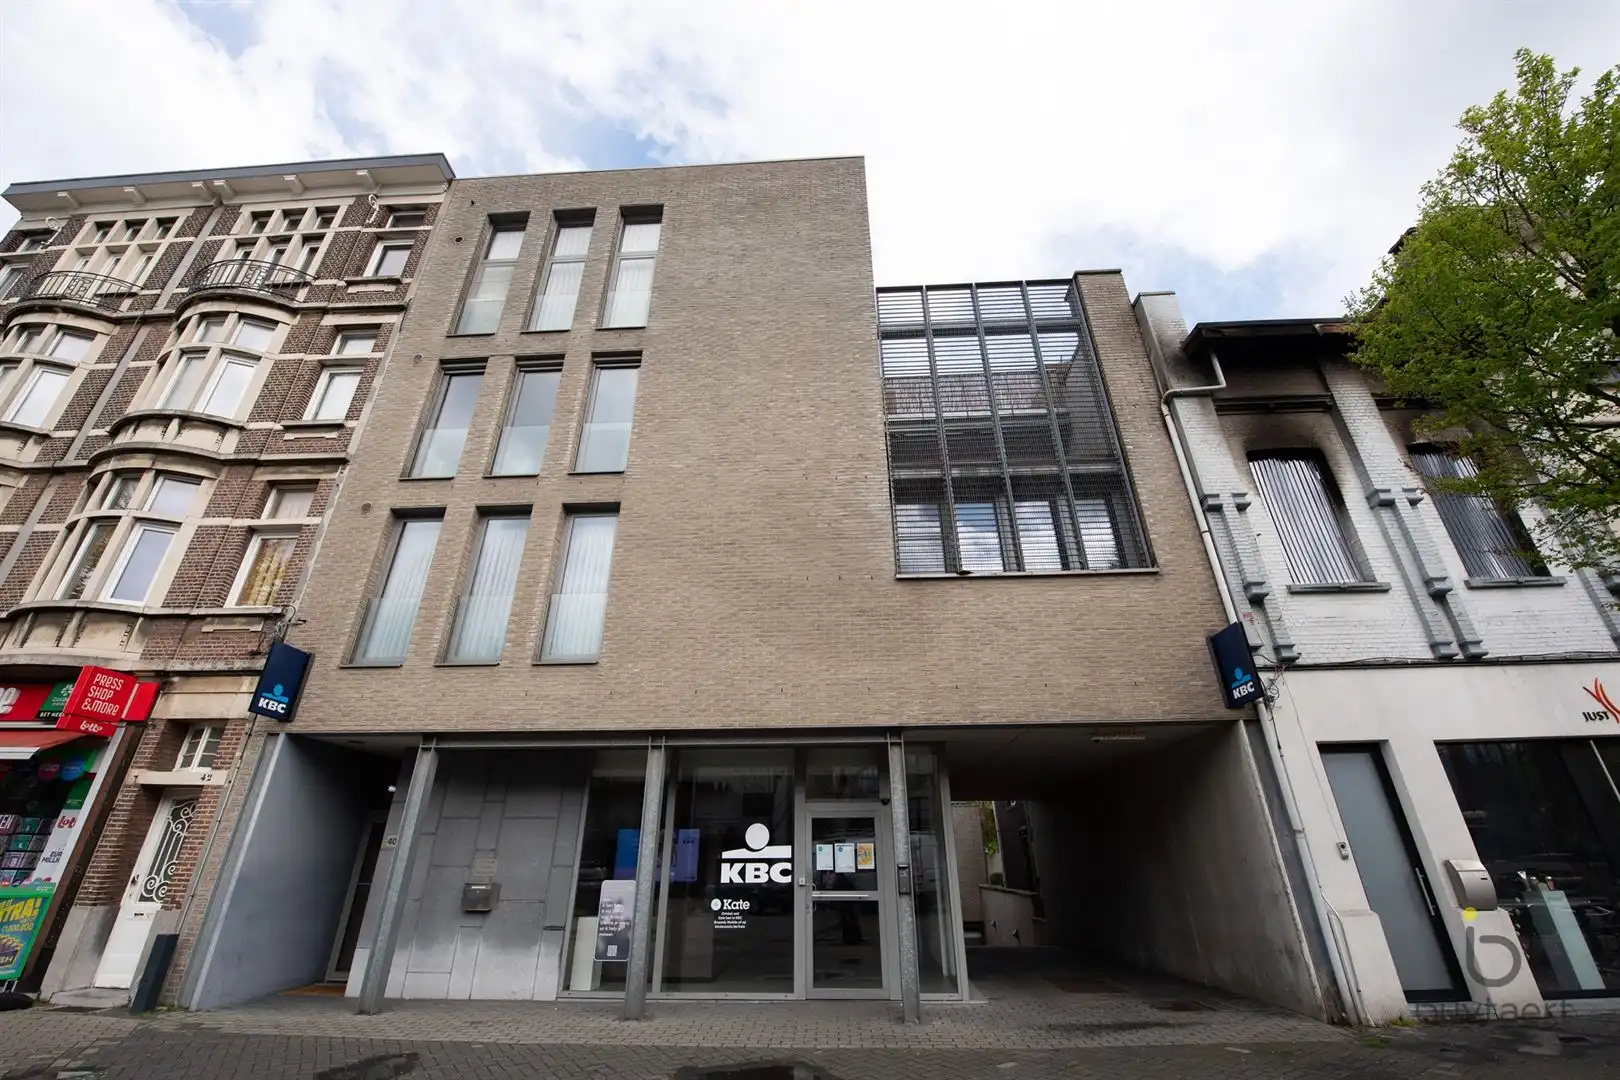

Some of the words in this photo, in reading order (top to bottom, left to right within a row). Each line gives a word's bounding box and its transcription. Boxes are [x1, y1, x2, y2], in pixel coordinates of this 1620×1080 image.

[93, 673, 124, 691] PRESS
[88, 685, 114, 701] SHOP
[1232, 681, 1255, 699] KBC
[258, 697, 287, 714] KBC
[1582, 711, 1609, 722] JUST
[200, 773, 213, 782] 42
[387, 837, 398, 846] 40
[50, 850, 63, 858] EUR
[720, 862, 792, 884] KBC
[723, 899, 750, 910] Kate
